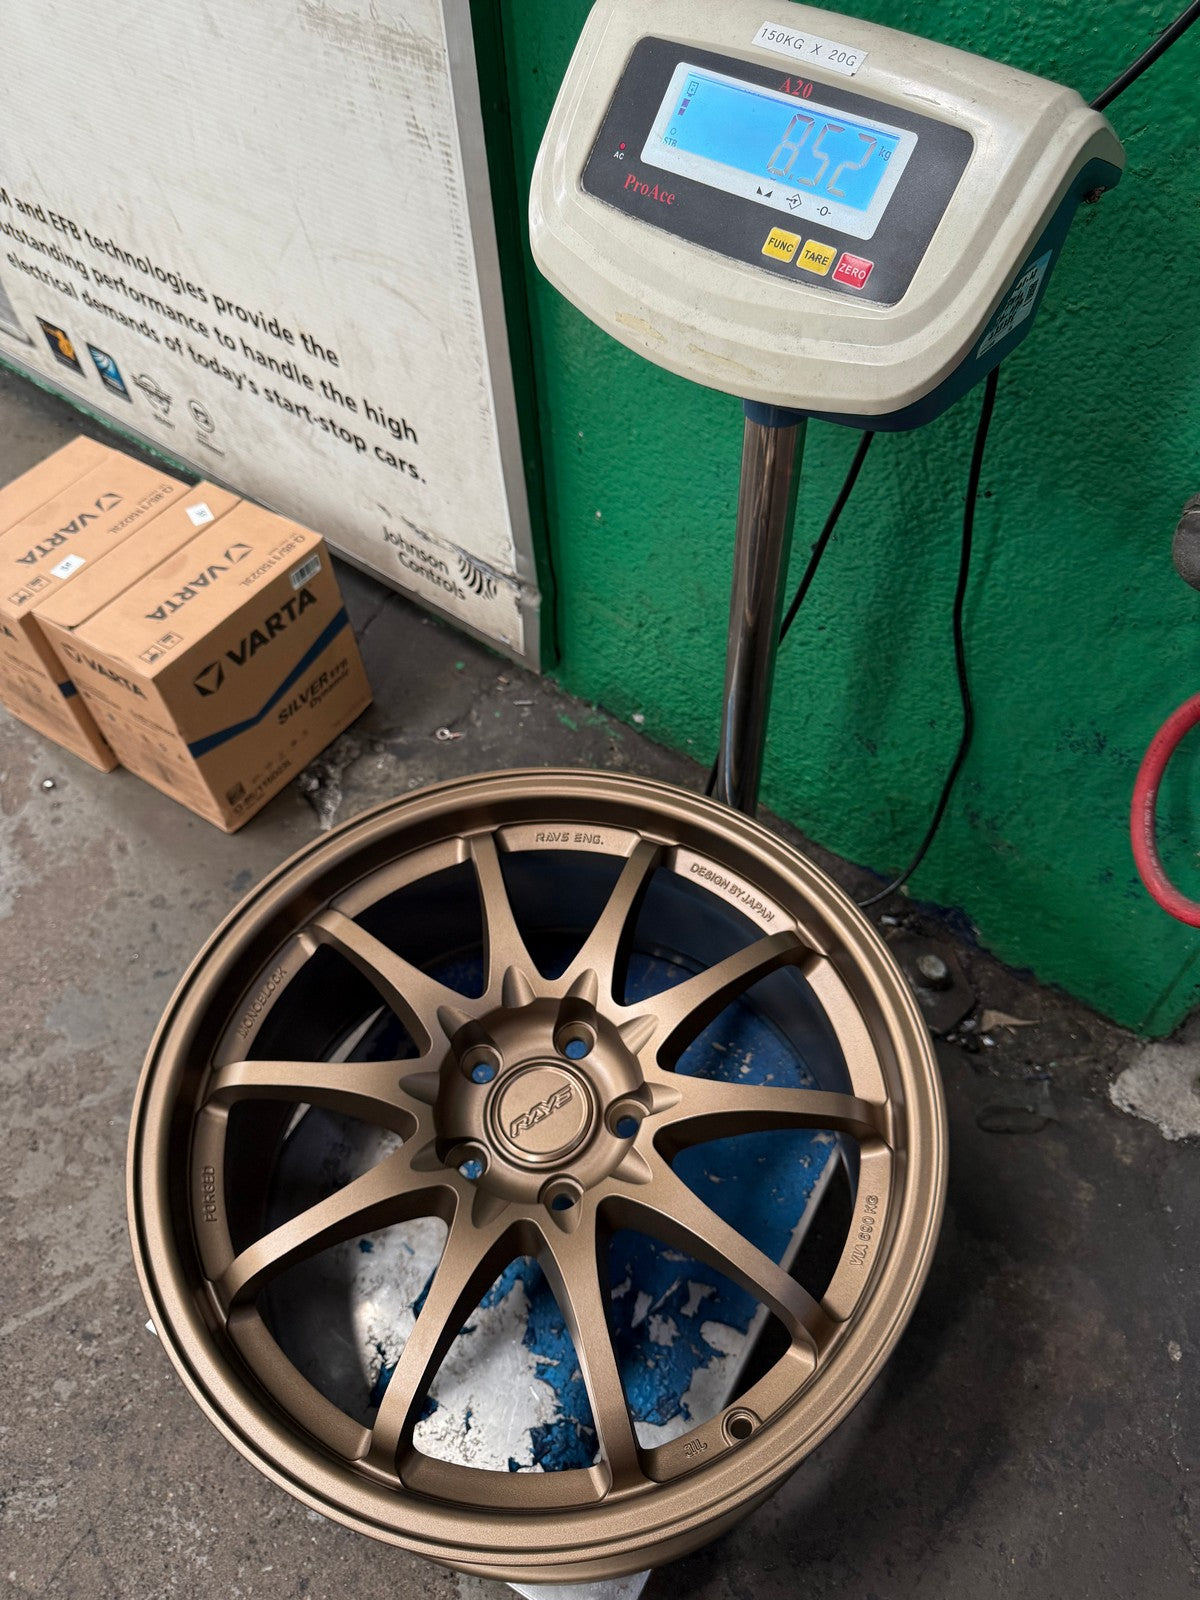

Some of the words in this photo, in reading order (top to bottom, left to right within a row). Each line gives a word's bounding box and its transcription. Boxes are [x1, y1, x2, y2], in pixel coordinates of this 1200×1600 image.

[761, 28, 805, 50] 150KG
[810, 43, 823, 55] X
[828, 49, 858, 67] 20G
[779, 77, 813, 99] A20
[613, 151, 625, 160] AC
[878, 144, 893, 161] kg
[623, 172, 676, 205] ProAce
[767, 237, 794, 253] FUNC
[804, 249, 830, 266] TARE
[15, 197, 47, 224] and
[48, 210, 81, 241] EFB
[85, 229, 208, 303] technologies
[212, 293, 296, 345] provide
[301, 331, 340, 367] the
[838, 263, 867, 280] ZERO
[7, 252, 78, 300] electrical
[82, 289, 161, 344] demands
[164, 335, 184, 356] of
[188, 344, 259, 395] today's
[264, 387, 367, 455] start-stop
[374, 445, 427, 484] cars.
[91, 268, 209, 338] performance
[213, 327, 236, 351] to
[240, 337, 315, 391] handle
[320, 380, 358, 413] the
[363, 399, 418, 445] high
[15, 513, 100, 565] VARTA
[383, 526, 450, 575] Johnson
[145, 565, 231, 622] VARTA
[398, 551, 466, 600] Controls
[225, 587, 318, 667] VARTA
[277, 670, 331, 725] SILVER
[574, 832, 604, 845] ENG.
[690, 863, 731, 890] DESIGN
[728, 884, 745, 898] BY
[741, 895, 775, 922] JAPAN
[238, 966, 287, 1039] MONOBLOCK
[509, 1083, 573, 1139] RAYS
[203, 1165, 218, 1222] FORGED
[864, 1194, 879, 1214] KG
[858, 1215, 875, 1241] 690
[850, 1244, 868, 1266] VIA
